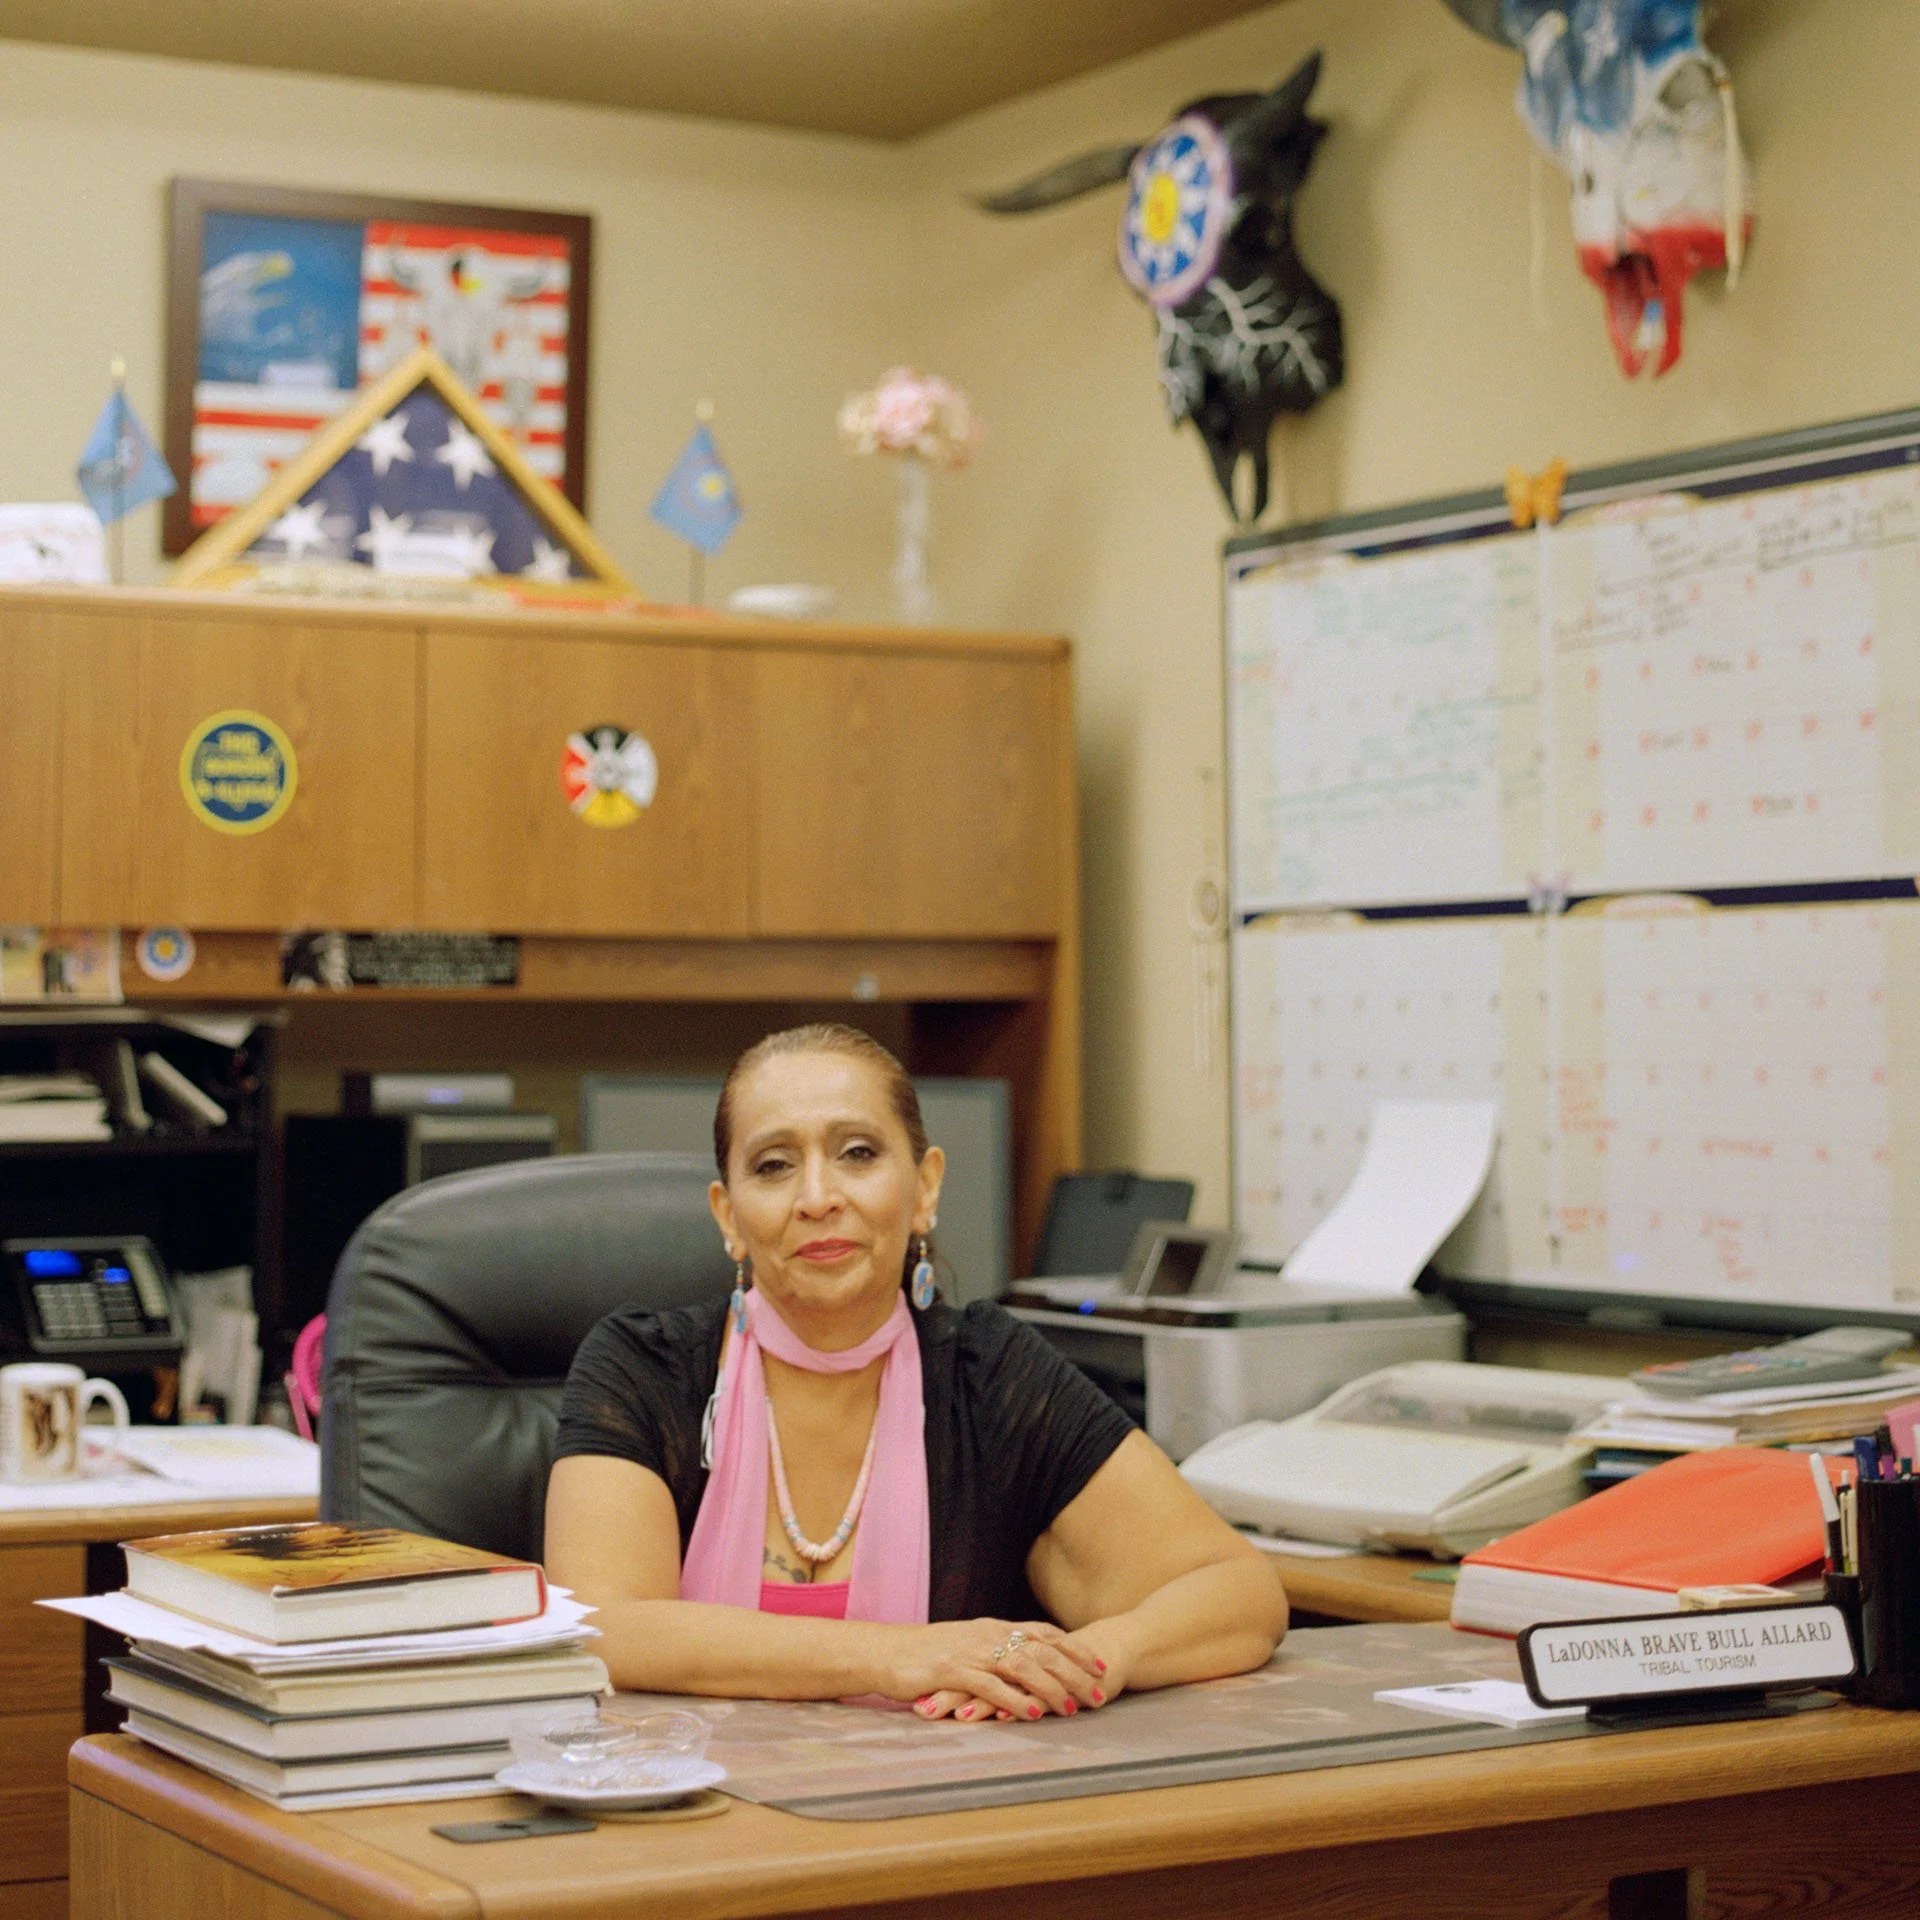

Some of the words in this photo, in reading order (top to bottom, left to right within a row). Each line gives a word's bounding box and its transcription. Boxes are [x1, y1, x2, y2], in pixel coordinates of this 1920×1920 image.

[1547, 1636, 1635, 1664] LaDONNA
[1640, 1632, 1701, 1657] BRAVE
[1706, 1628, 1754, 1651] BULL
[1761, 1621, 1832, 1646] ALLARD
[1639, 1658, 1691, 1677] TRIBAL
[1695, 1653, 1757, 1673] TOURISM
